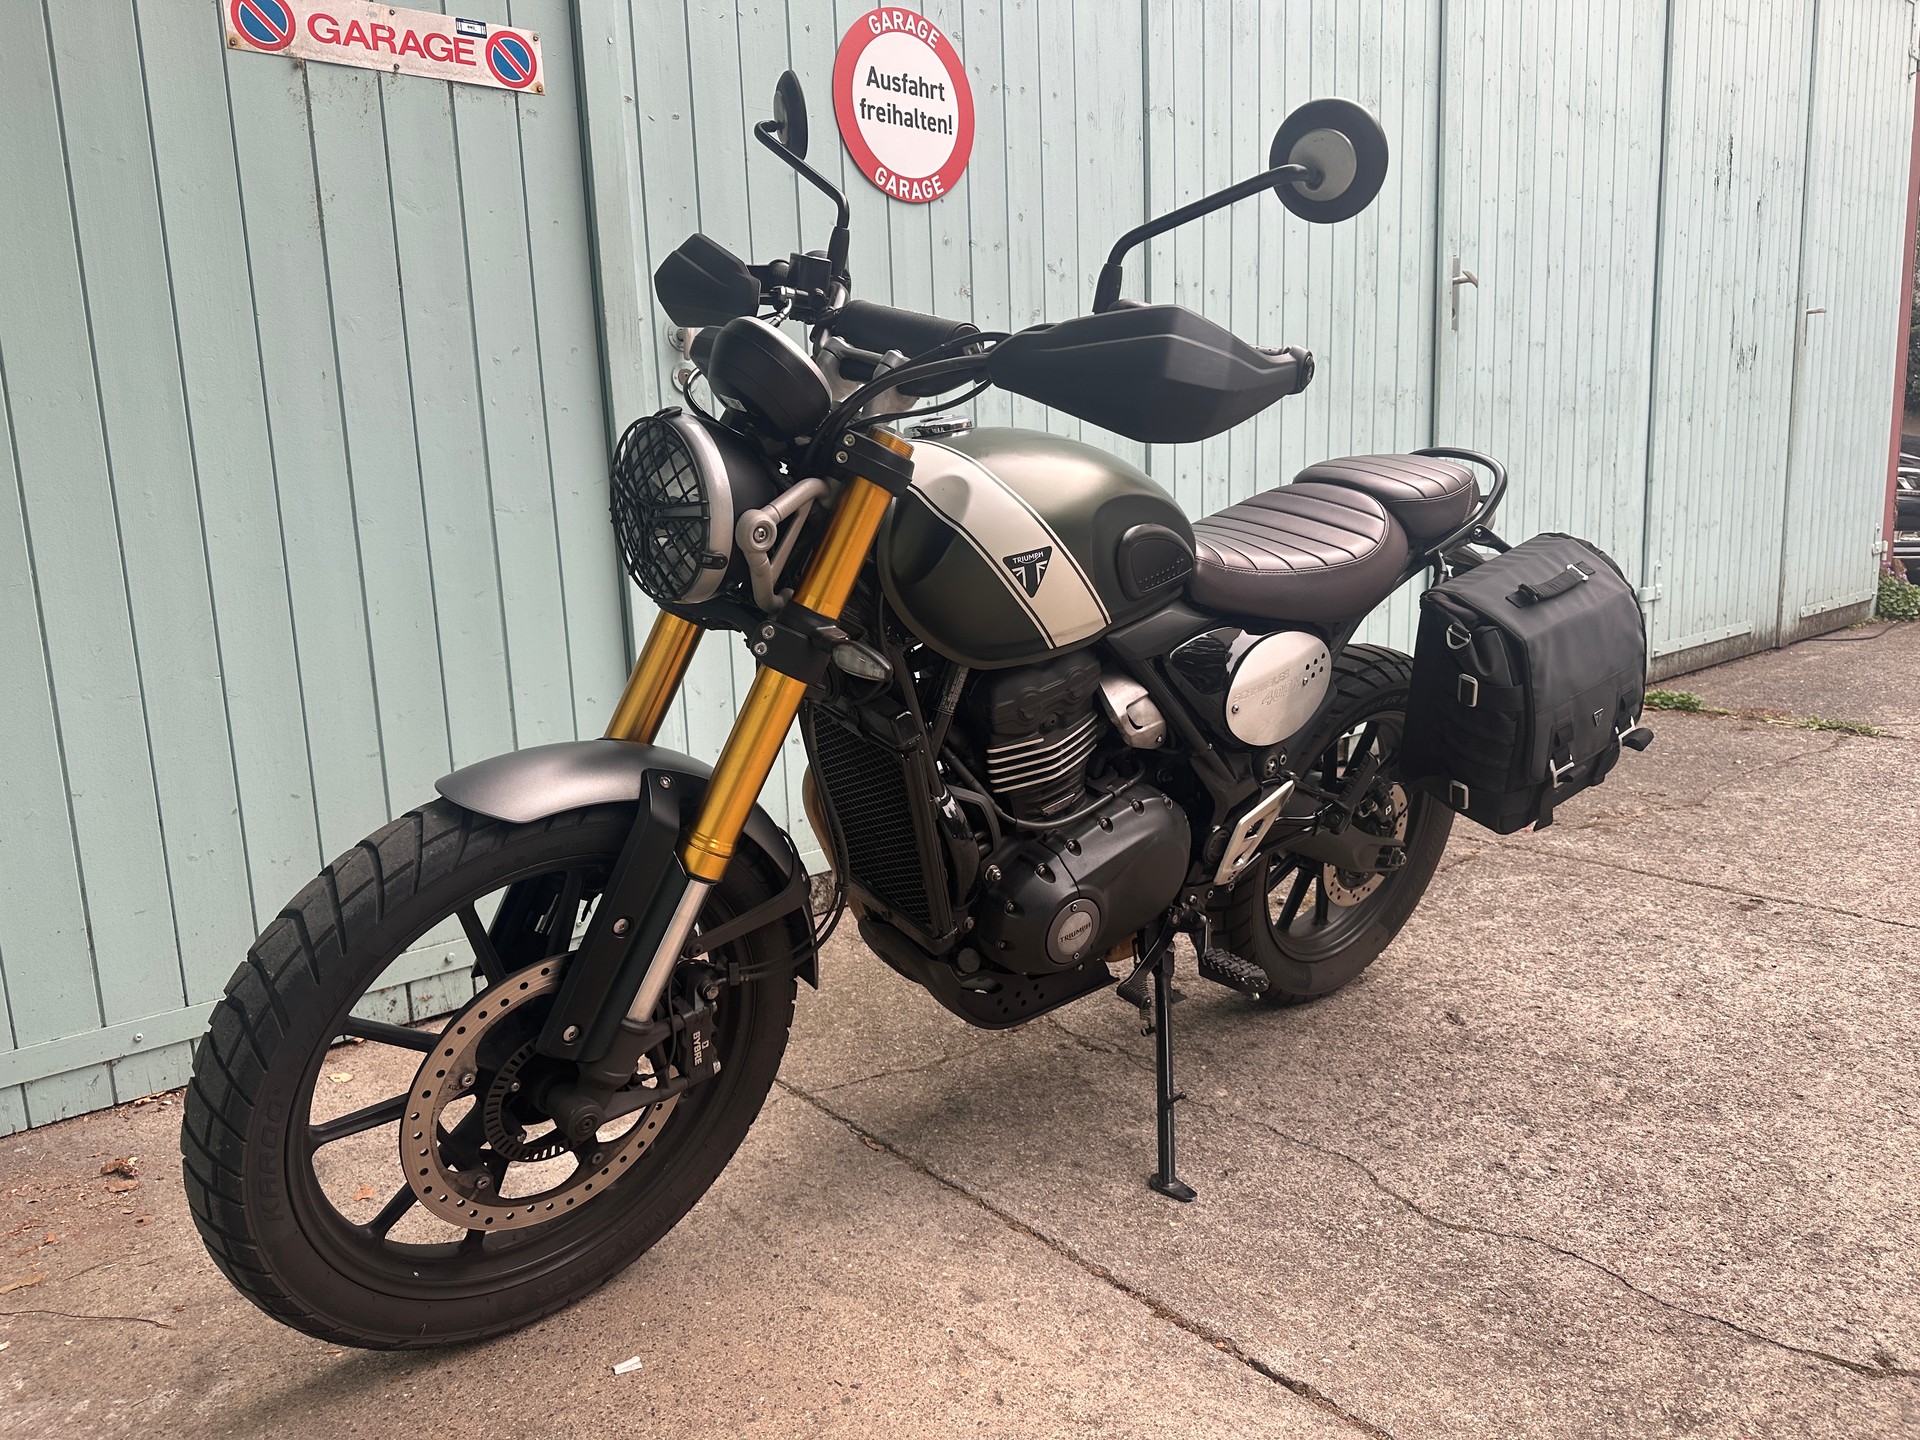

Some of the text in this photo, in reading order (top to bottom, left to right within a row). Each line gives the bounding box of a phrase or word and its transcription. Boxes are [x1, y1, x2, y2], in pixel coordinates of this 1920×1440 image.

[307, 13, 477, 67] GARAGE
[868, 10, 940, 49] GARAGE
[866, 65, 945, 101] Ausfahrt
[859, 98, 953, 135] freihalten!
[874, 166, 944, 200] GARAGE
[1012, 550, 1044, 565] TRIUMPH
[1060, 922, 1091, 943] TRIUMPH
[693, 1031, 703, 1066] BYBRE
